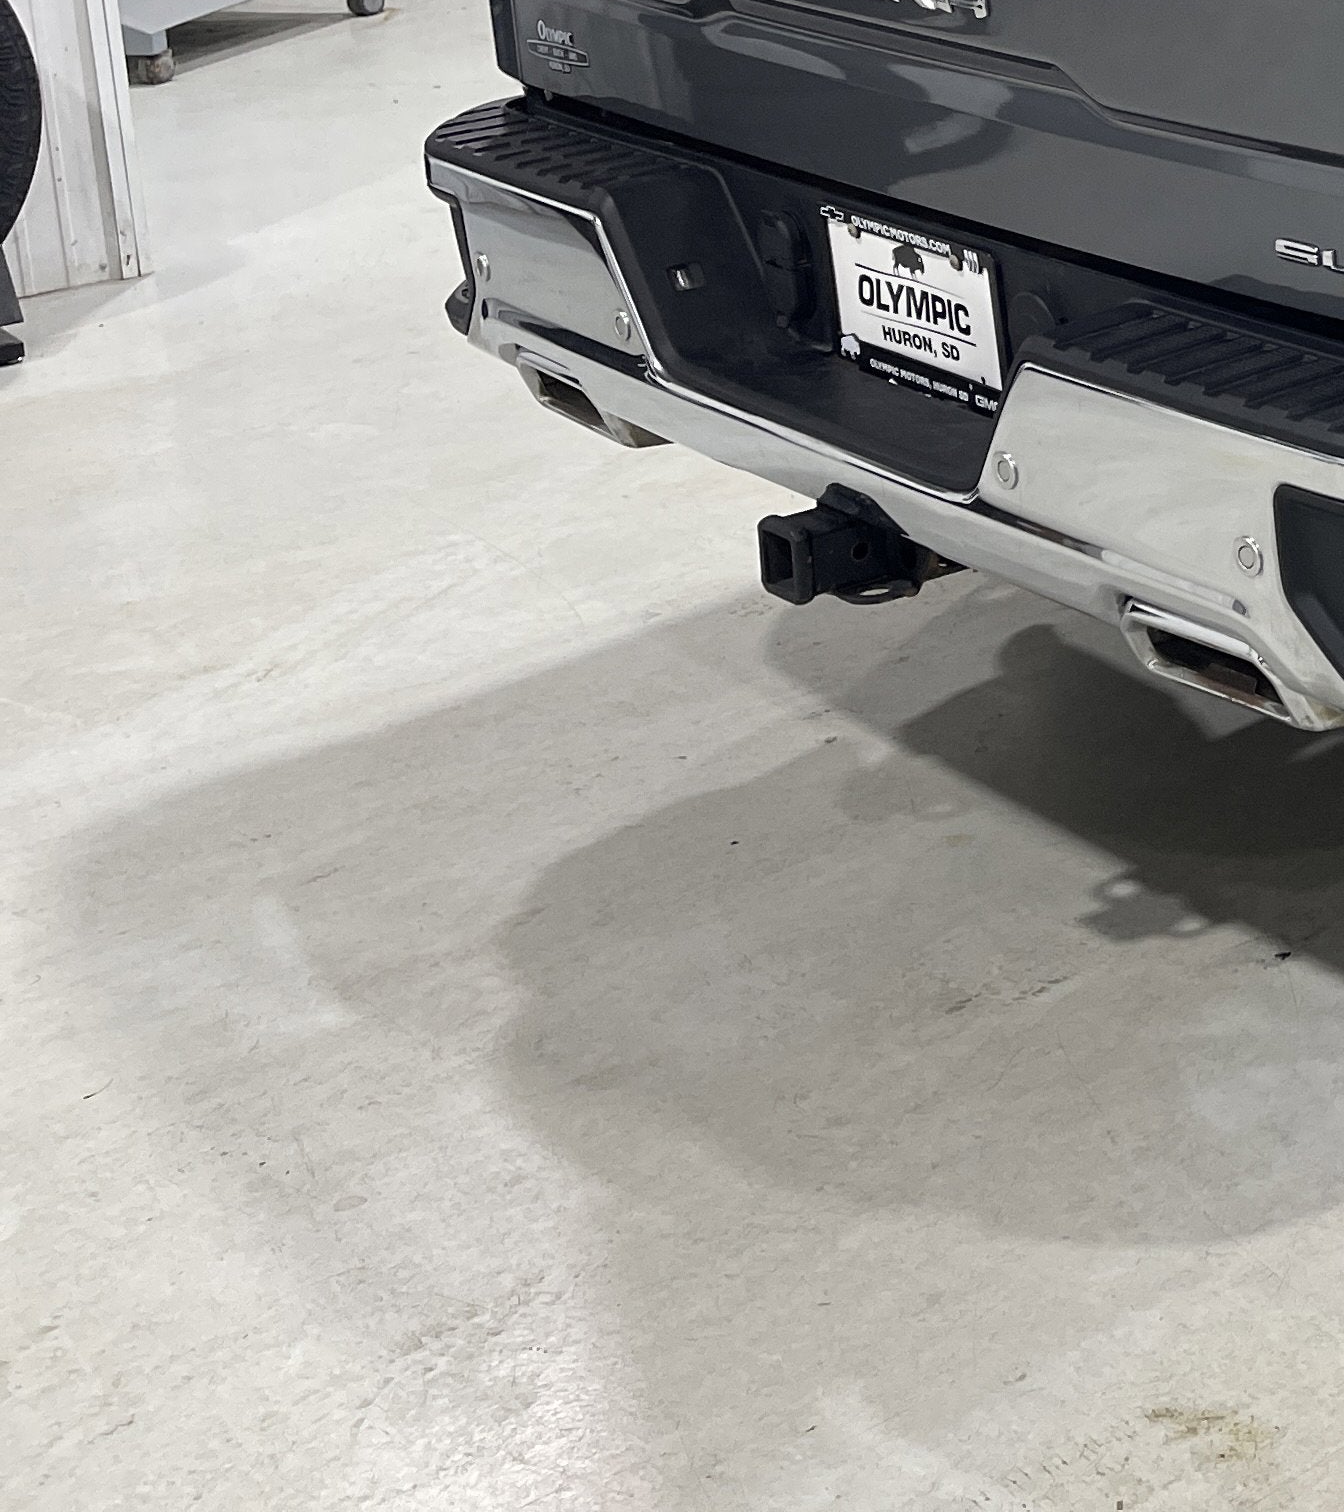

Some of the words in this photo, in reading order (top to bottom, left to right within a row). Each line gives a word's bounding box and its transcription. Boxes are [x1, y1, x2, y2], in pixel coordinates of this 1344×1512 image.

[851, 215, 951, 259] OLYMPICMOTORS.COM
[857, 273, 972, 338] OLYMPIC
[881, 324, 942, 358] HURON,
[941, 338, 960, 362] SD
